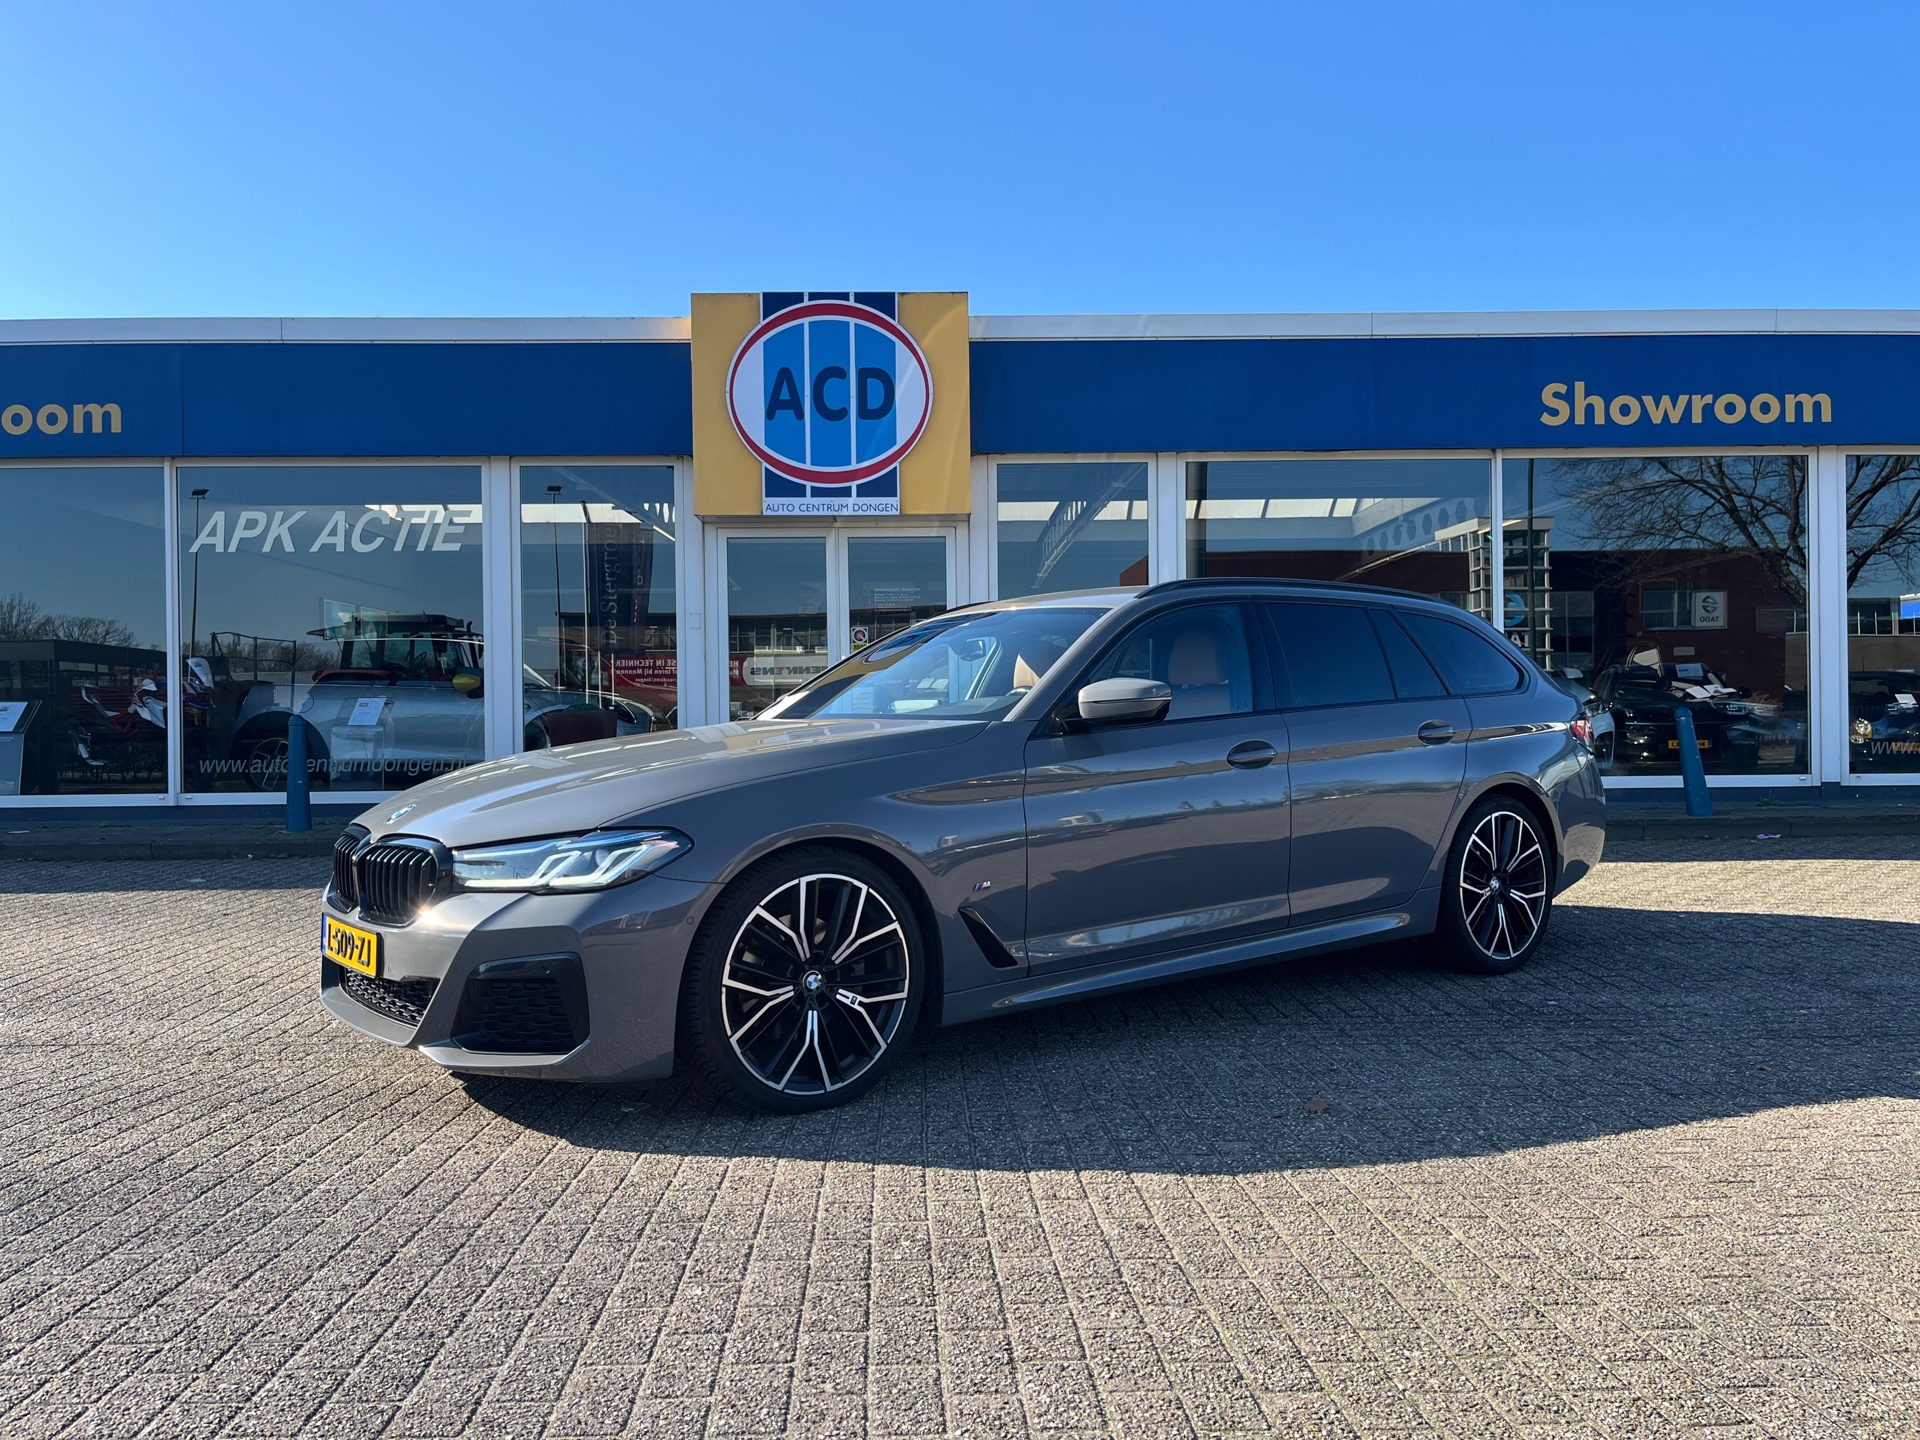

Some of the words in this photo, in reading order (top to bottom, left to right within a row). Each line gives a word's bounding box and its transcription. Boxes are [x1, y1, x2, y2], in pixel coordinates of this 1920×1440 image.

[765, 365, 896, 422] ACD
[1539, 381, 1833, 426] Showroom
[764, 503, 796, 513] AUTO
[798, 503, 849, 513] CENTRUM
[852, 503, 899, 513] DONGEN
[189, 510, 308, 553] APK
[310, 509, 471, 553] ACTIE
[600, 523, 622, 614] Stergroe
[199, 756, 467, 777] www.autoentrumdongen.nl
[327, 922, 372, 969] L-509-ZJ
